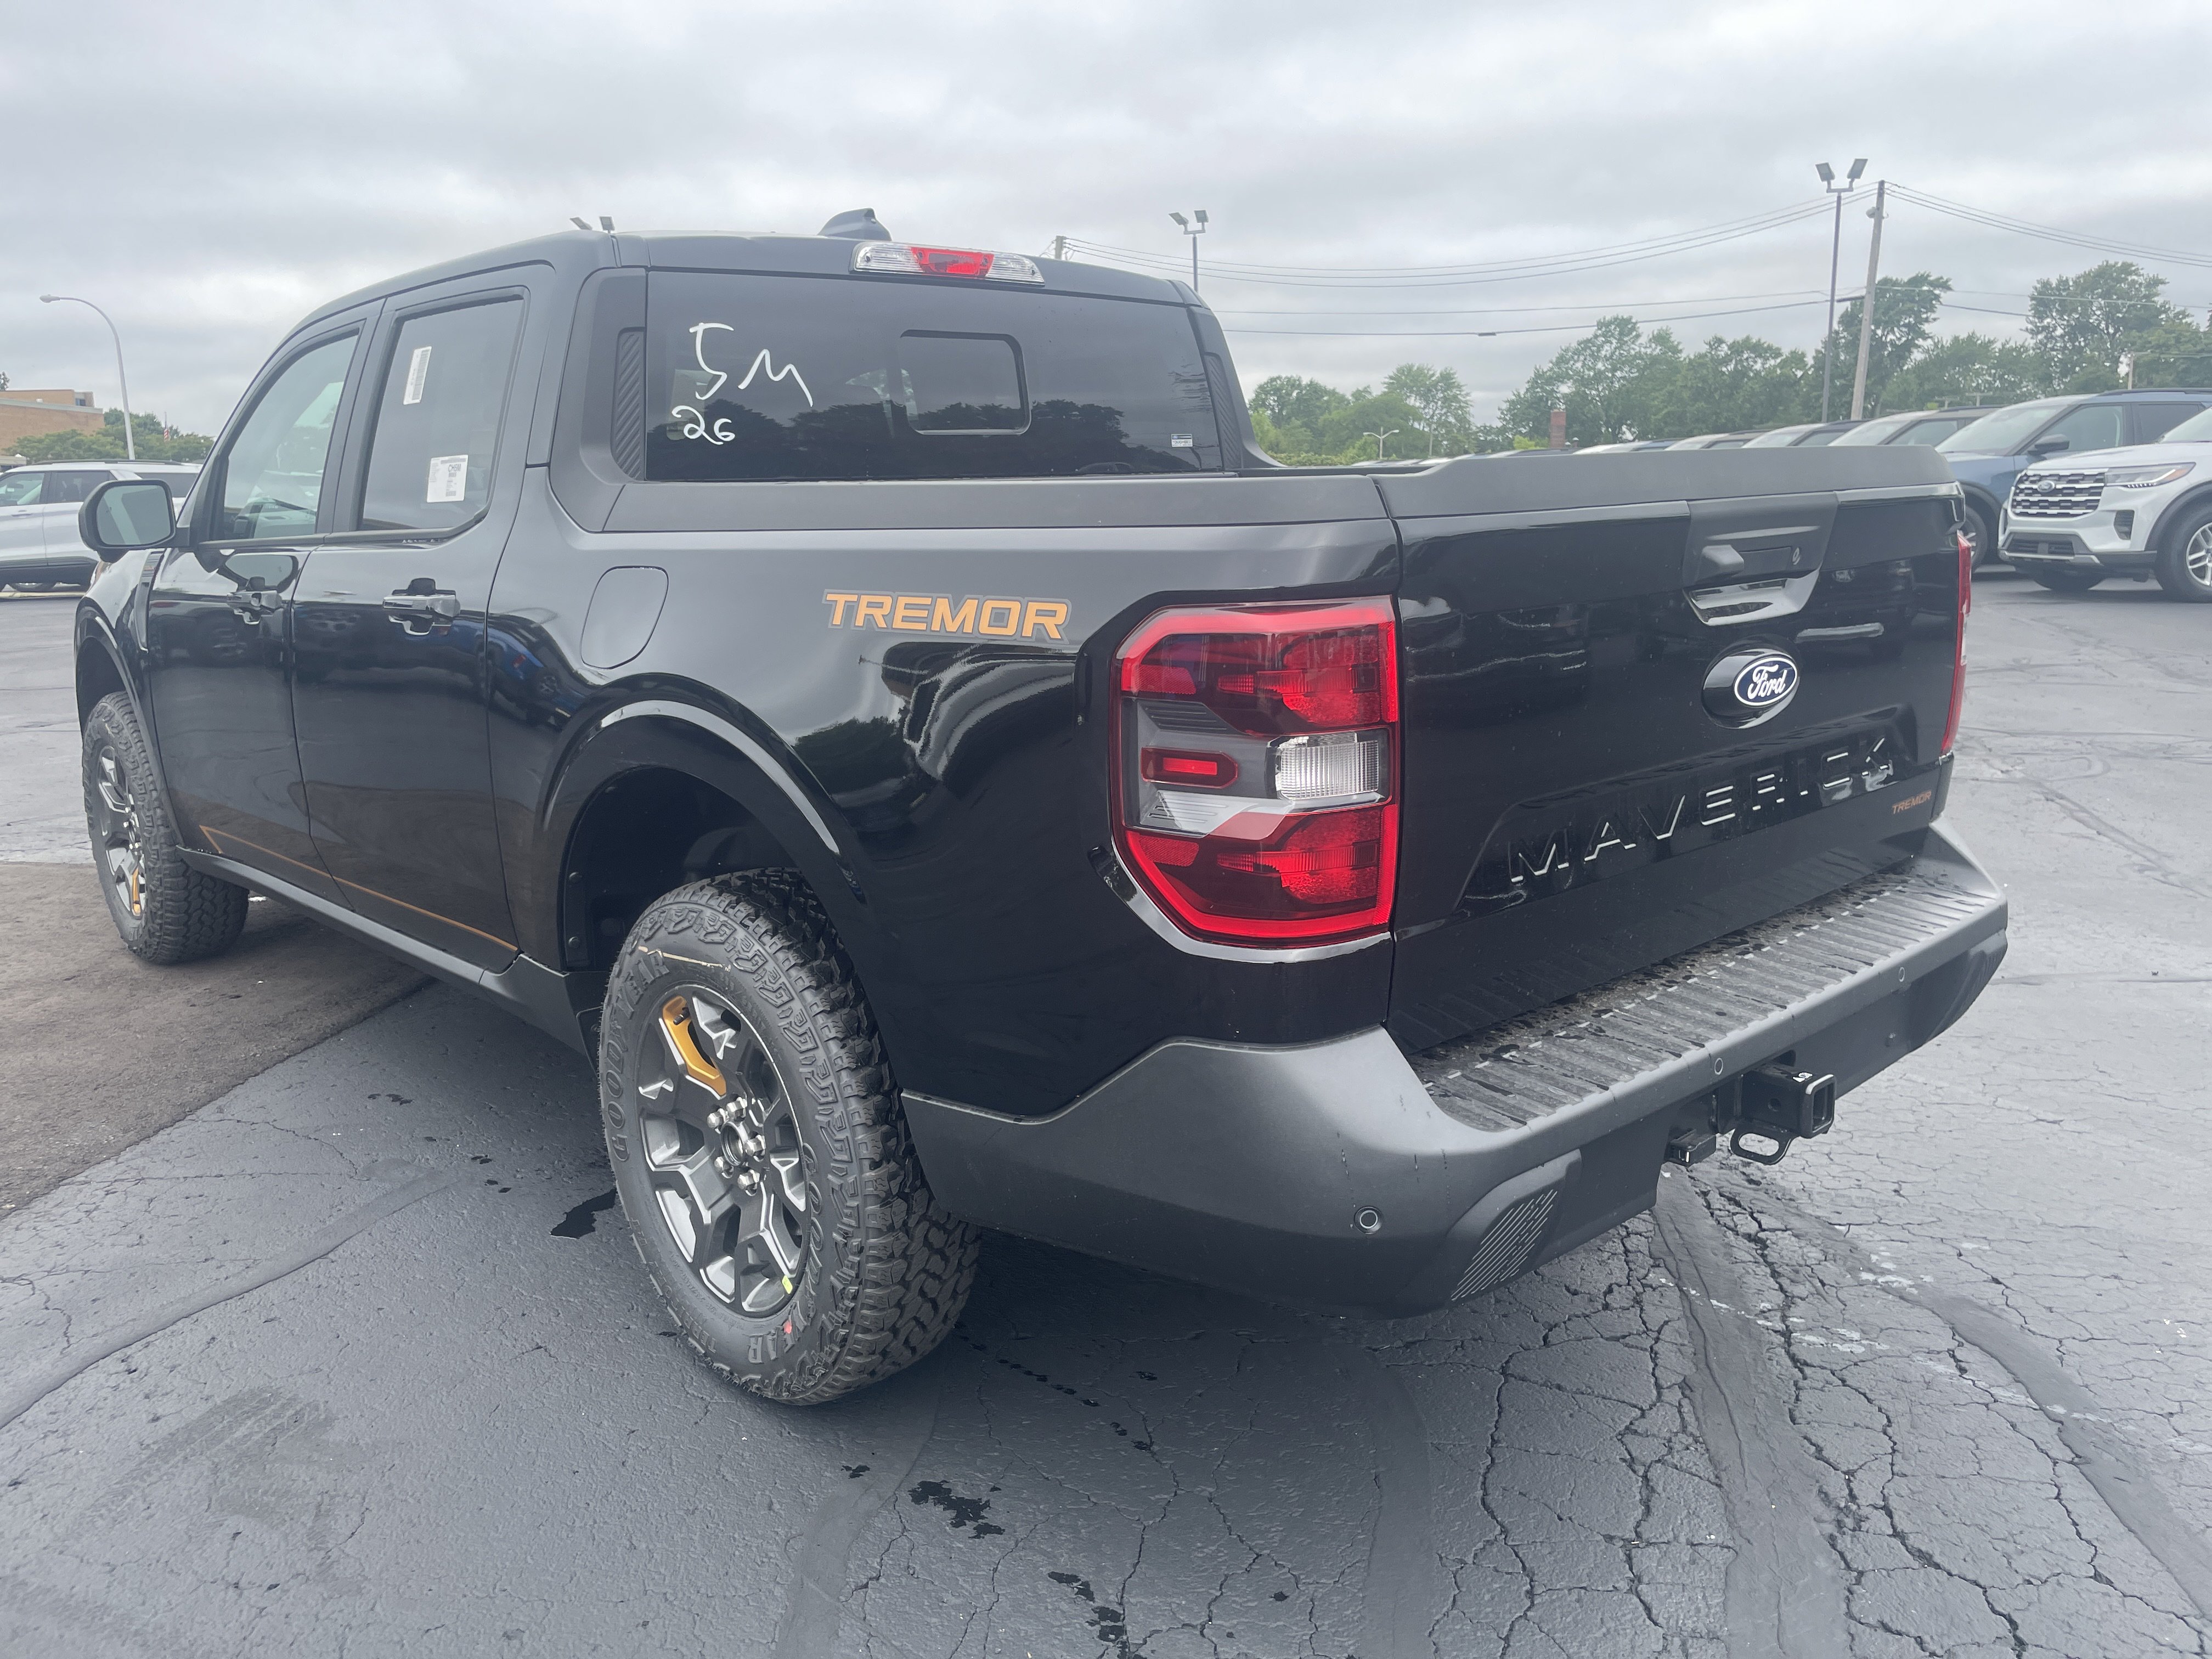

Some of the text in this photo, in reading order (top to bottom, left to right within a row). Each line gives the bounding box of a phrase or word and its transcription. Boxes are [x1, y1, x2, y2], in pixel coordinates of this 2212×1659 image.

[824, 591, 1070, 642] TREMOR
[1747, 664, 1788, 700] Ford
[1892, 790, 1932, 814] TREMOR
